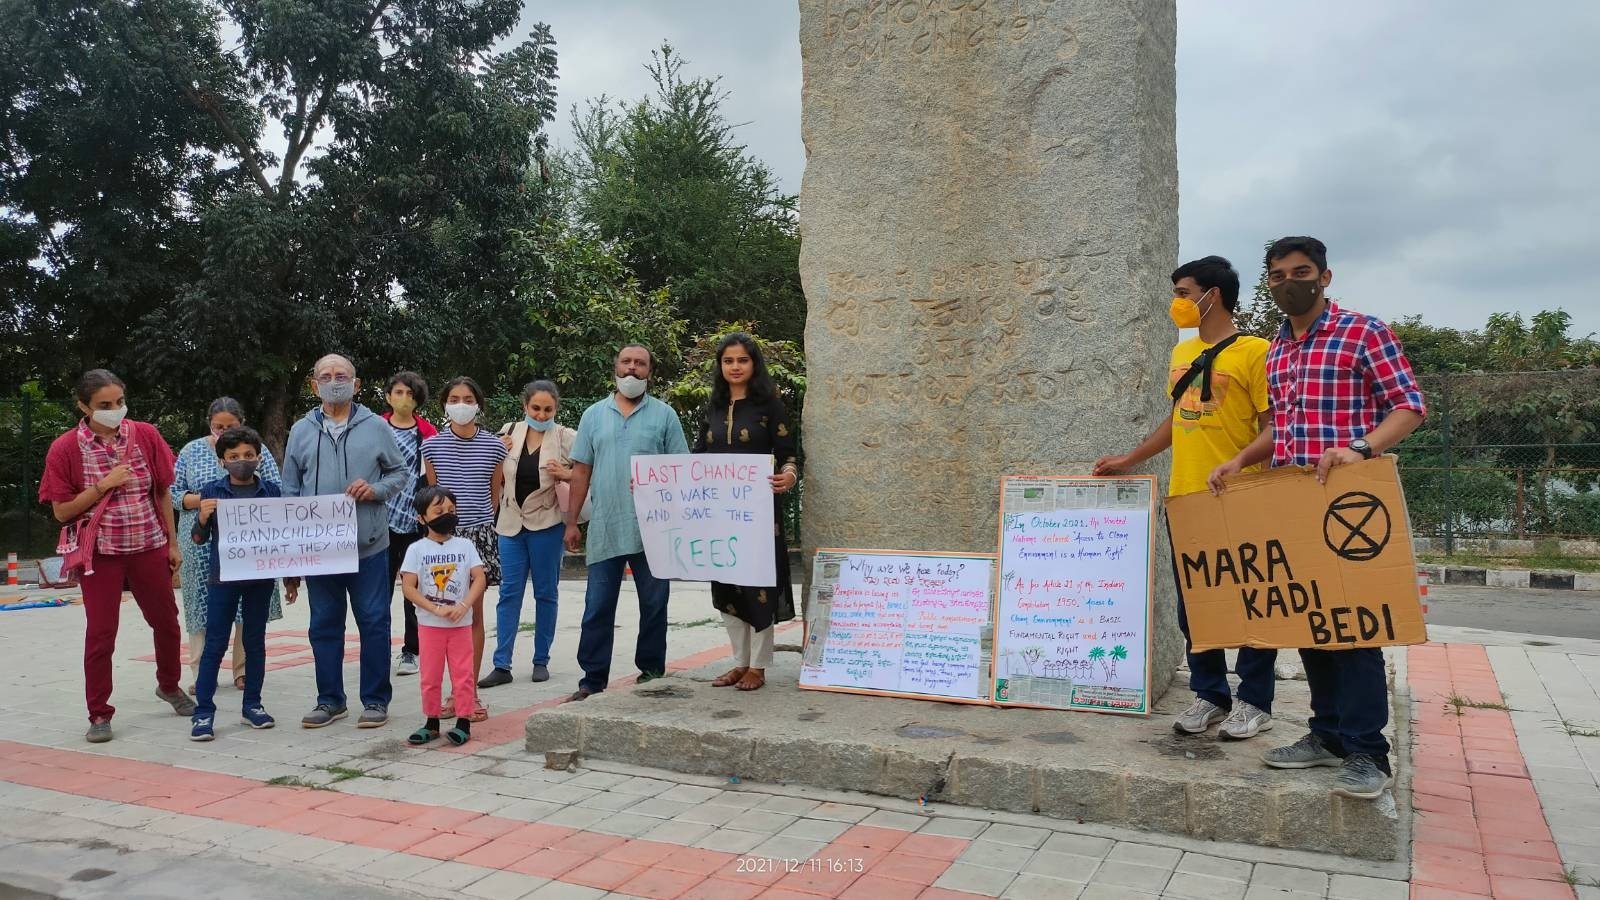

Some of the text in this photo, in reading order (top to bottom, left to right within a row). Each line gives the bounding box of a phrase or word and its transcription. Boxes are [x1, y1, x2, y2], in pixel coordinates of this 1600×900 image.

[635, 461, 758, 486] LAST CHANCE
[656, 485, 753, 502] TO WAKE UP
[225, 501, 355, 527] HERE FOR MY
[646, 507, 753, 522] AND SAVE THE
[1031, 516, 1061, 529] October
[1104, 516, 1127, 526] United
[227, 523, 356, 544] GRANDCHILDREN
[1012, 534, 1037, 543] Nations
[1096, 531, 1104, 540] to
[227, 541, 357, 560] SO THAT THEY MAY
[661, 528, 738, 574] TREES
[1077, 547, 1101, 560] Human
[256, 556, 322, 571] BREATHE
[421, 553, 466, 566] POWERED BY
[1182, 539, 1293, 589] MARA
[850, 560, 873, 577] Why
[877, 564, 894, 574] are
[1107, 597, 1114, 606] to
[1242, 580, 1322, 620] KADI
[1308, 603, 1395, 645] BEDI
[1058, 630, 1079, 641] RIGHT
[1083, 632, 1097, 640] and
[1101, 631, 1107, 640] A
[1111, 631, 1136, 641] HUMAN
[1056, 646, 1079, 657] RIGHT
